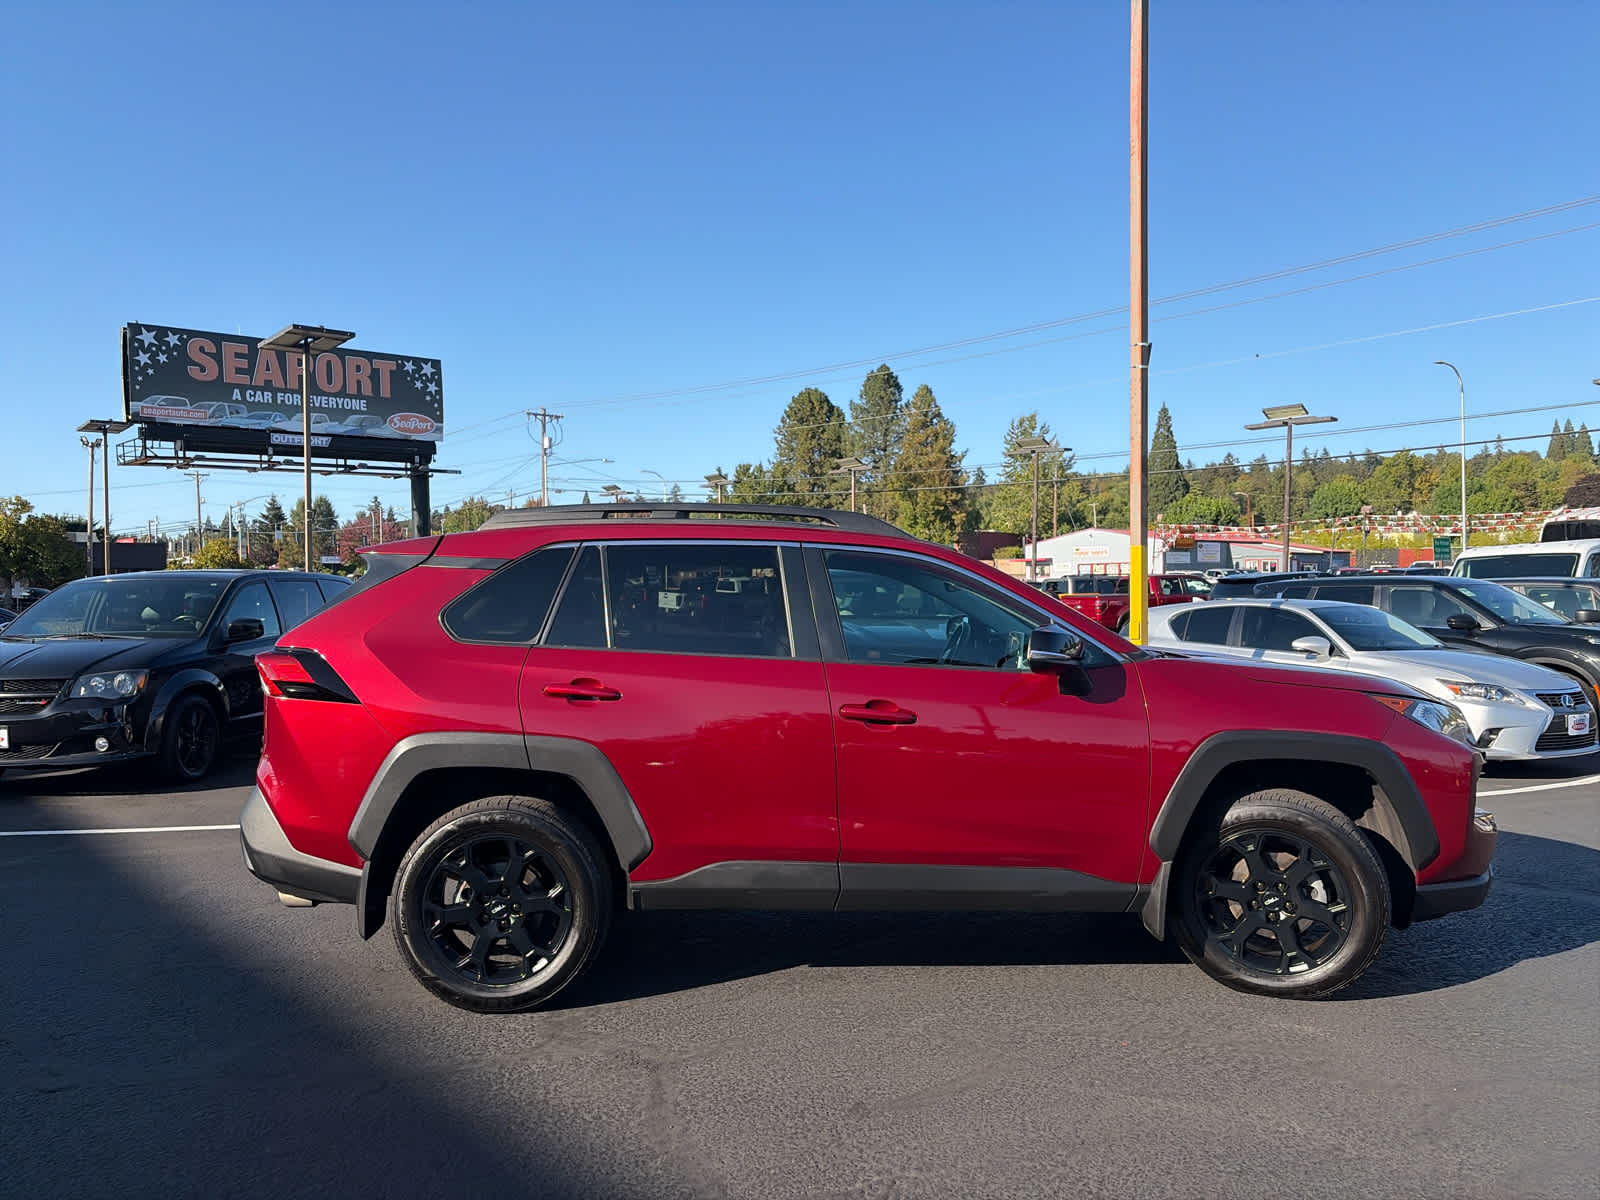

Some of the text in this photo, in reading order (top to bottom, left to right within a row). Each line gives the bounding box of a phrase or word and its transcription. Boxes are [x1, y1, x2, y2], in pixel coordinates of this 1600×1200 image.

[187, 337, 397, 398] SEAPORT
[232, 388, 242, 401] A
[246, 389, 272, 404] CAR
[277, 392, 301, 407] FOR
[143, 407, 205, 419] seaportauto.com
[272, 434, 328, 447] OUTFNT
